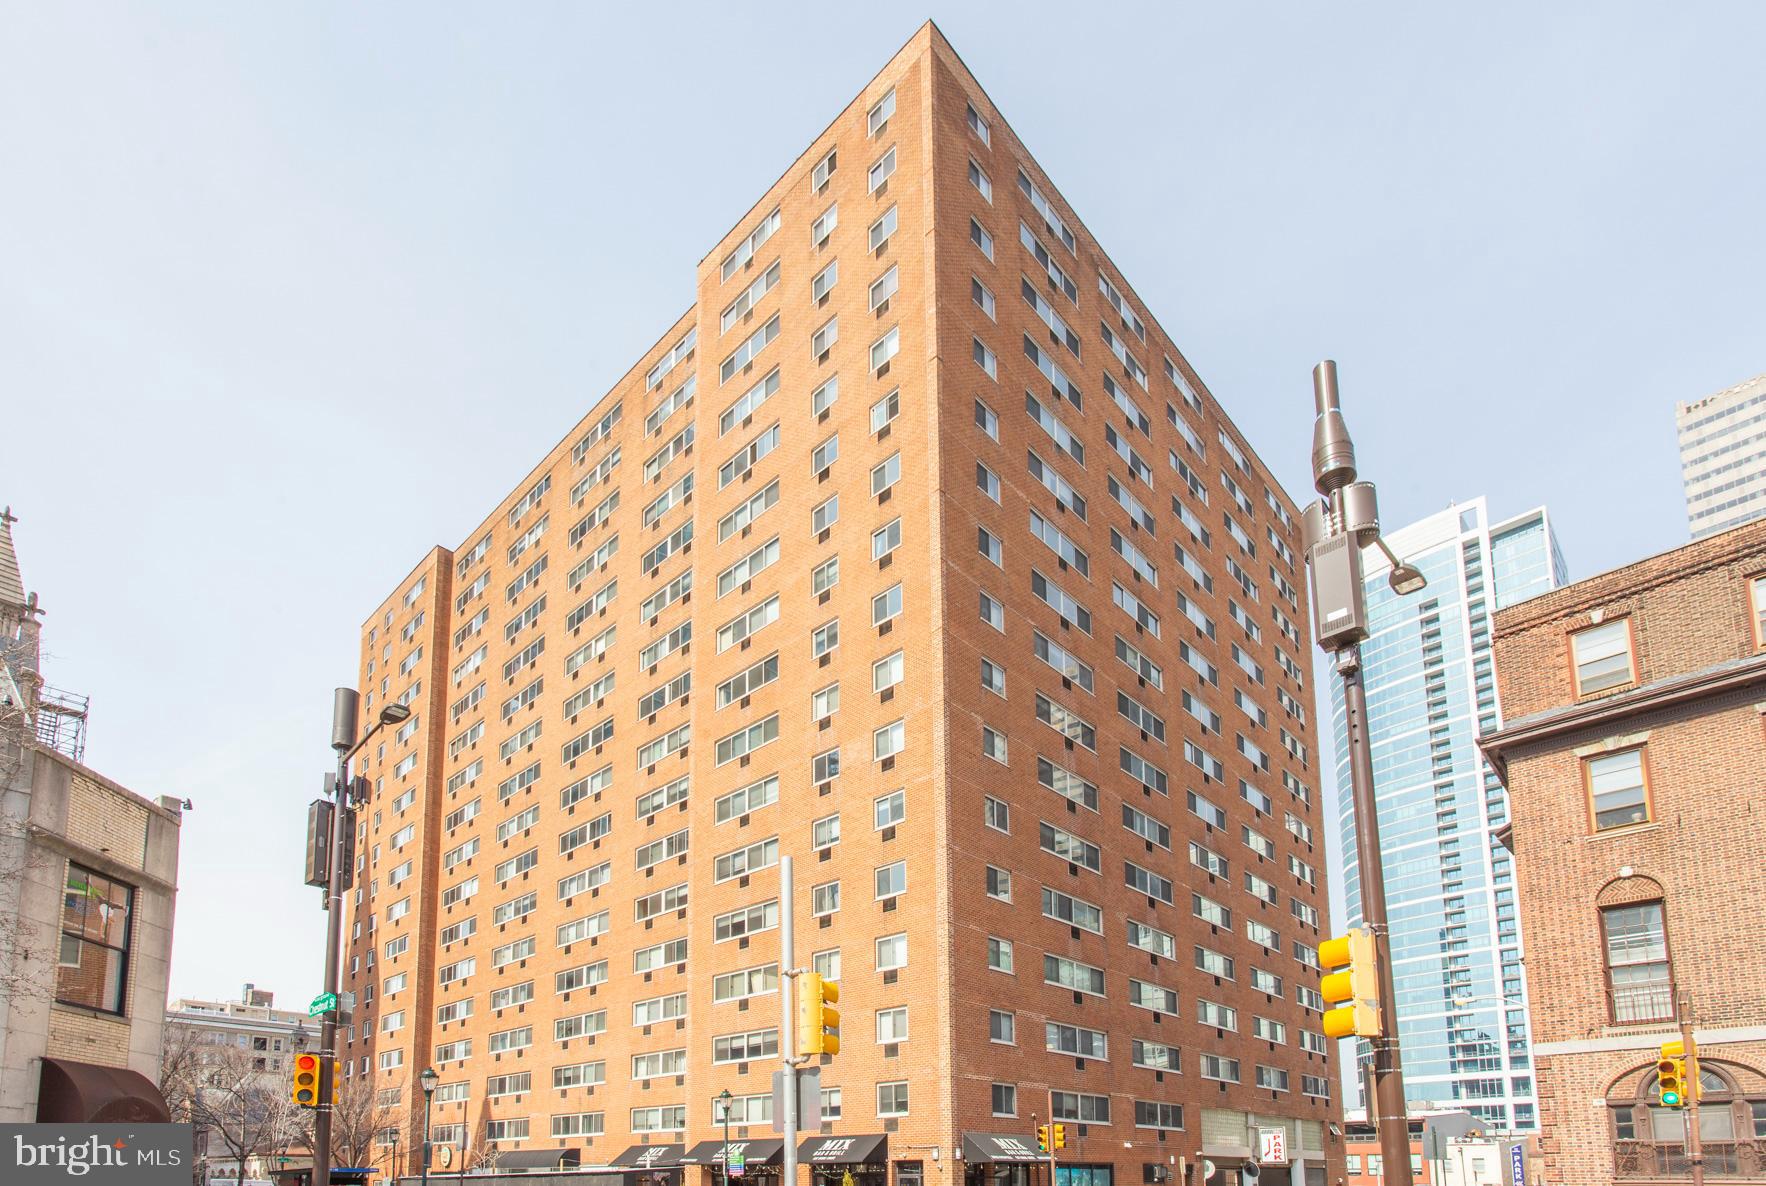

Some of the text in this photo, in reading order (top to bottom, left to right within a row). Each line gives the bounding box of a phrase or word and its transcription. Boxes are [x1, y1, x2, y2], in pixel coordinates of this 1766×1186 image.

[818, 1138, 856, 1150] MIX
[991, 1137, 1028, 1150] MIX
[1273, 1135, 1283, 1160] PARK
[1513, 1155, 1523, 1180] PARK
